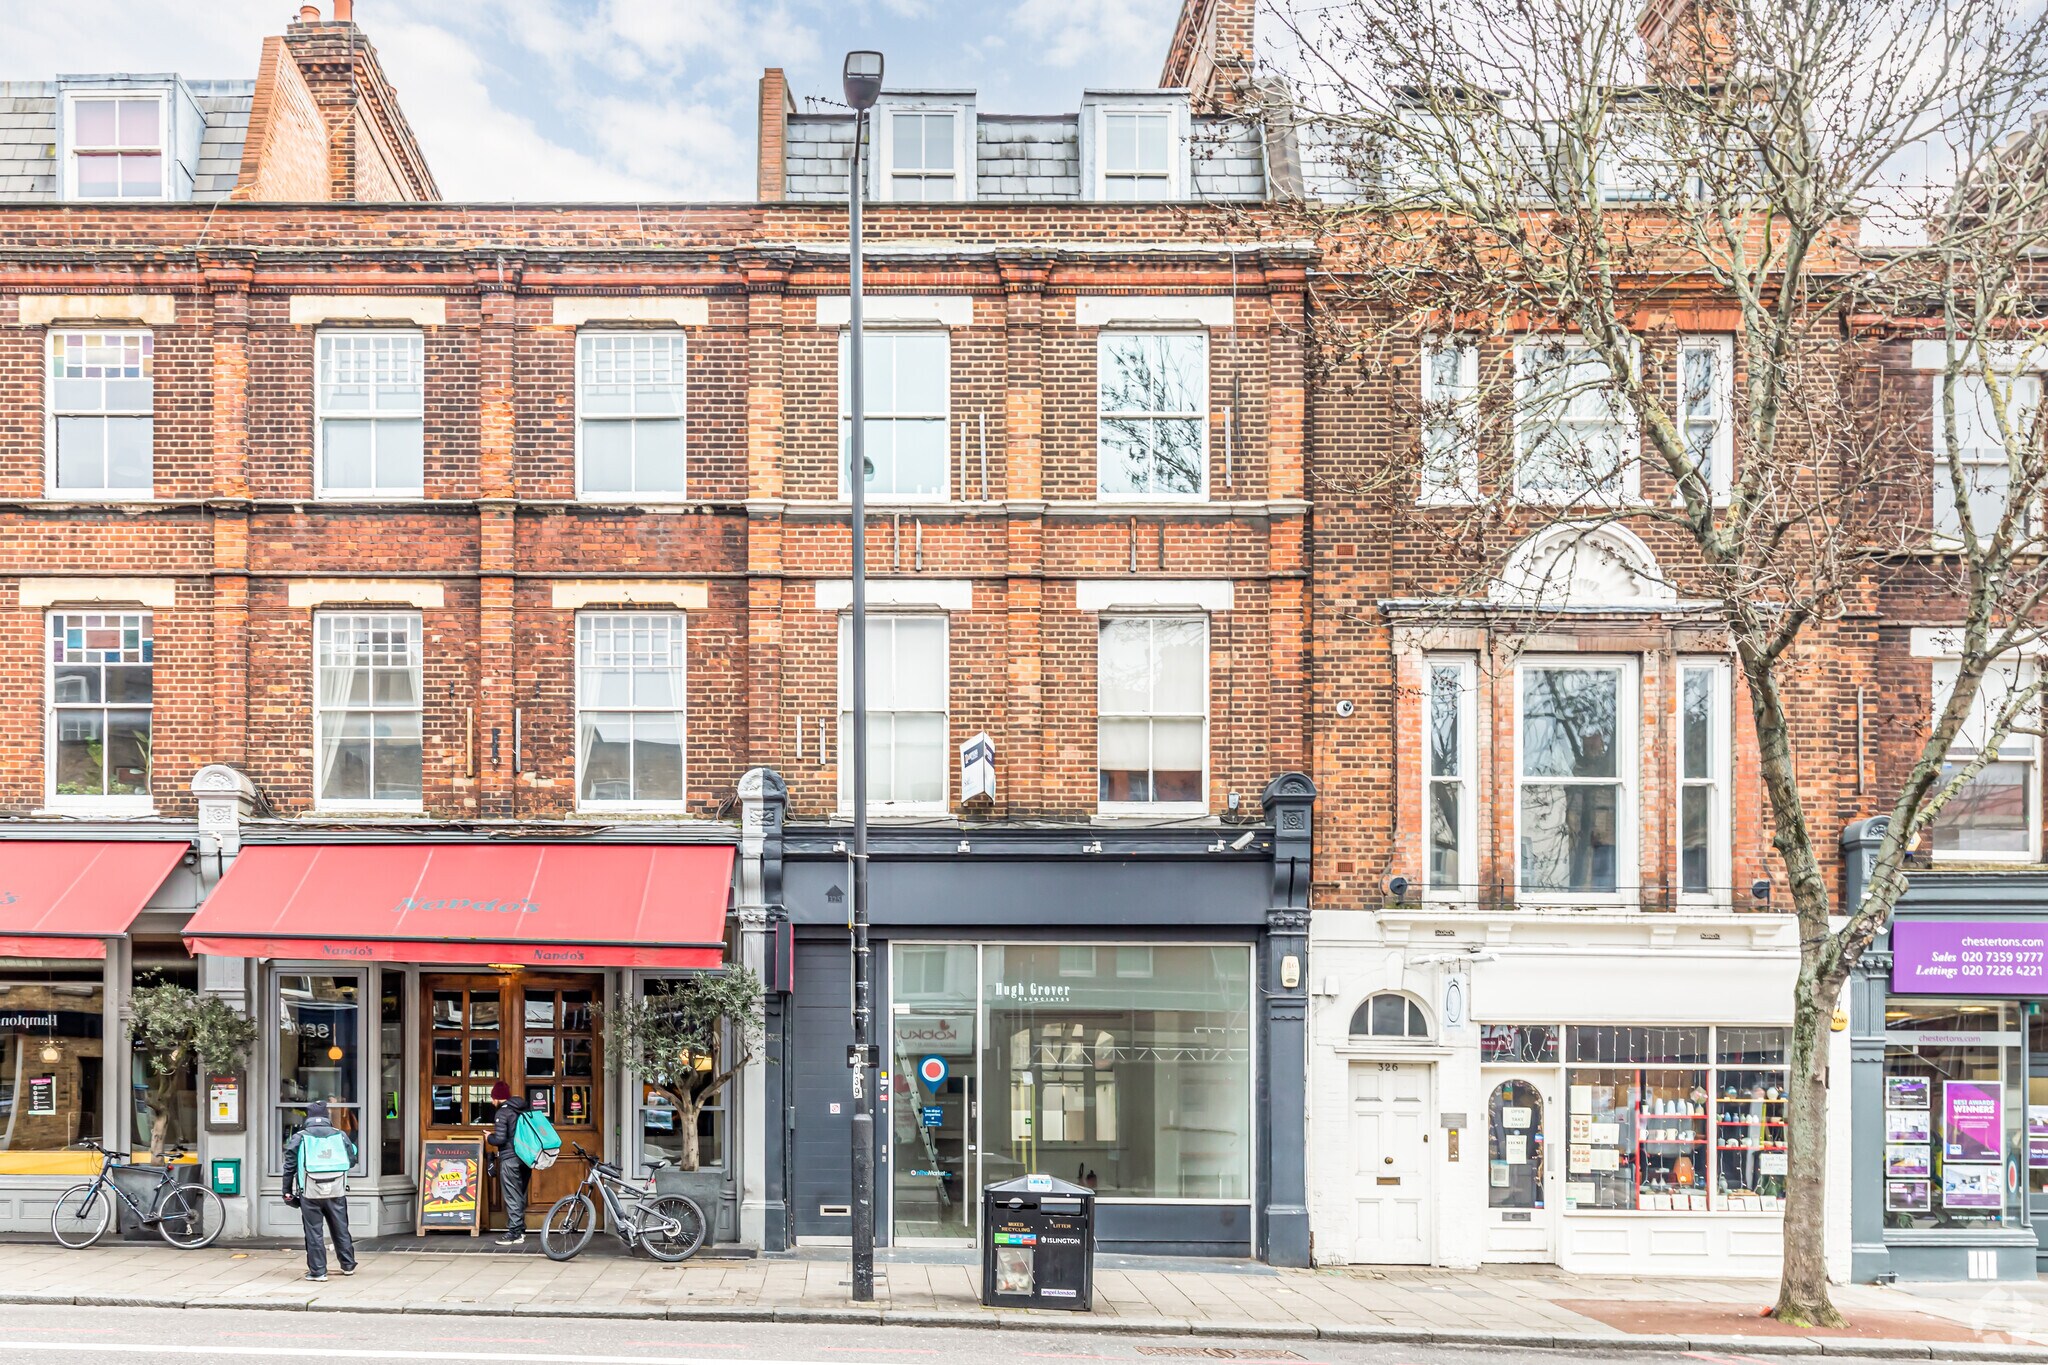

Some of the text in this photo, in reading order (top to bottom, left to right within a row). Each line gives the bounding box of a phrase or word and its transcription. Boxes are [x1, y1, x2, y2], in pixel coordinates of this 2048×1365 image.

[391, 898, 541, 913] Nando's
[1961, 937, 2044, 947] chestertons.com
[322, 944, 373, 956] Nando's
[533, 949, 585, 961] Nando's
[1932, 952, 2044, 962] Sales 020 7359 9777
[1916, 965, 2043, 979] Lettings 020 7226 4221
[995, 982, 1070, 998] Hugh Grover
[1919, 1034, 1981, 1043] chestertons.com
[1377, 1062, 1398, 1071] 326
[1953, 1105, 1994, 1113] WINNERS
